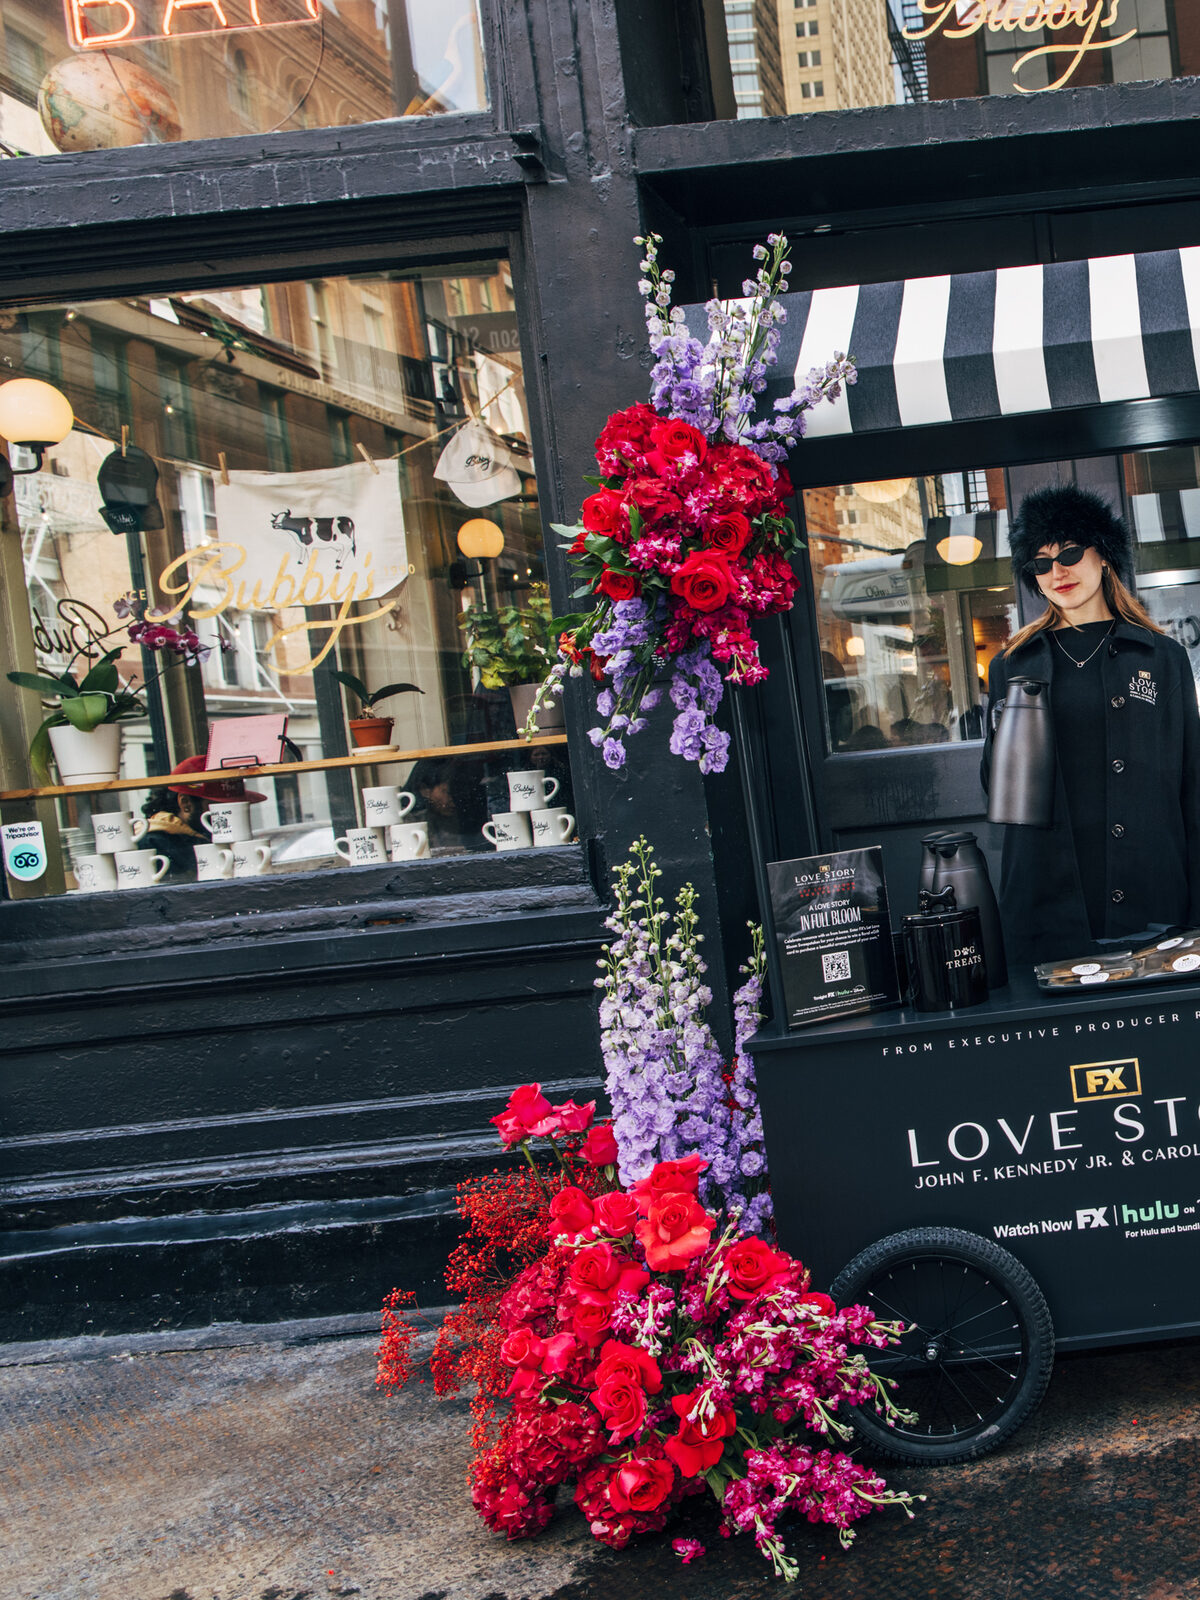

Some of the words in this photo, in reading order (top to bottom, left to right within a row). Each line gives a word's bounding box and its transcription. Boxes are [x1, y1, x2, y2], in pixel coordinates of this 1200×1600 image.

[145, 542, 397, 675] Bubby's
[1128, 682, 1159, 698] STORY
[1132, 676, 1156, 691] LOVE
[5, 830, 40, 840] Tripadvisor
[8, 827, 26, 835] We're
[795, 871, 823, 884] LOVE
[824, 867, 857, 880] STORY
[814, 901, 831, 911] LOVE
[831, 899, 851, 909] STORY
[800, 915, 811, 932] IN
[811, 910, 832, 931] FULL
[946, 954, 982, 970] TREATS
[882, 1042, 934, 1056] FROM
[949, 1027, 1061, 1049] EXECUTIVE
[1075, 1013, 1181, 1034] PRODUCER
[1086, 1066, 1128, 1095] FX
[907, 1109, 1083, 1168] LOVE
[914, 1171, 965, 1190] JOHN
[972, 1168, 989, 1183] F.
[994, 1158, 1079, 1181] KENNEDY
[1085, 1152, 1113, 1170] JR.
[1121, 1150, 1136, 1166] &
[993, 1221, 1040, 1239] Watch
[1041, 1219, 1073, 1234] Now
[1076, 1206, 1110, 1230] FX
[1122, 1200, 1180, 1224] hulu
[1184, 1205, 1195, 1214] ON
[1125, 1229, 1140, 1239] For
[1140, 1226, 1160, 1238] Hulu
[1160, 1224, 1176, 1235] and
